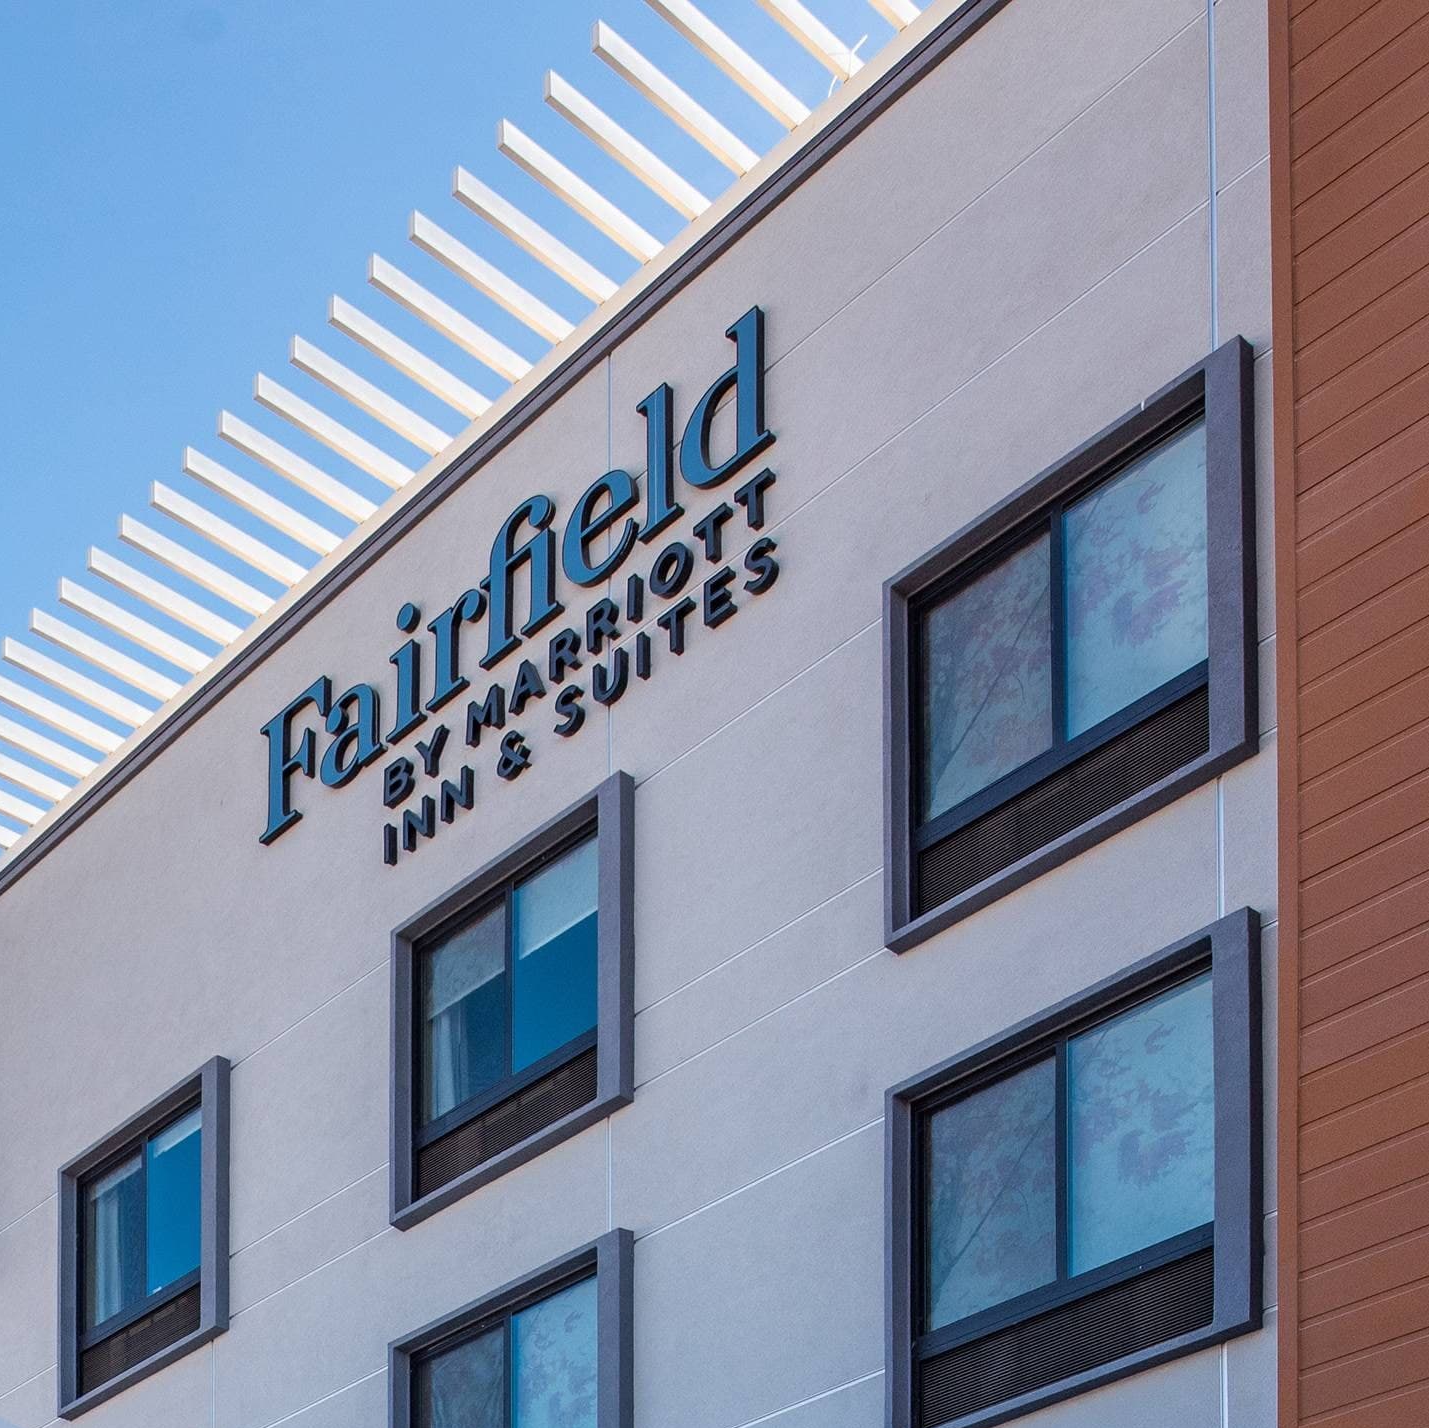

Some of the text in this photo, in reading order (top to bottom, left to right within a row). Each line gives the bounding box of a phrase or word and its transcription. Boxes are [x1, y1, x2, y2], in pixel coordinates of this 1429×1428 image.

[259, 305, 776, 845] Fairfield
[383, 467, 776, 808] BY MARRIOTT
[383, 537, 779, 866] INN & SUITES
